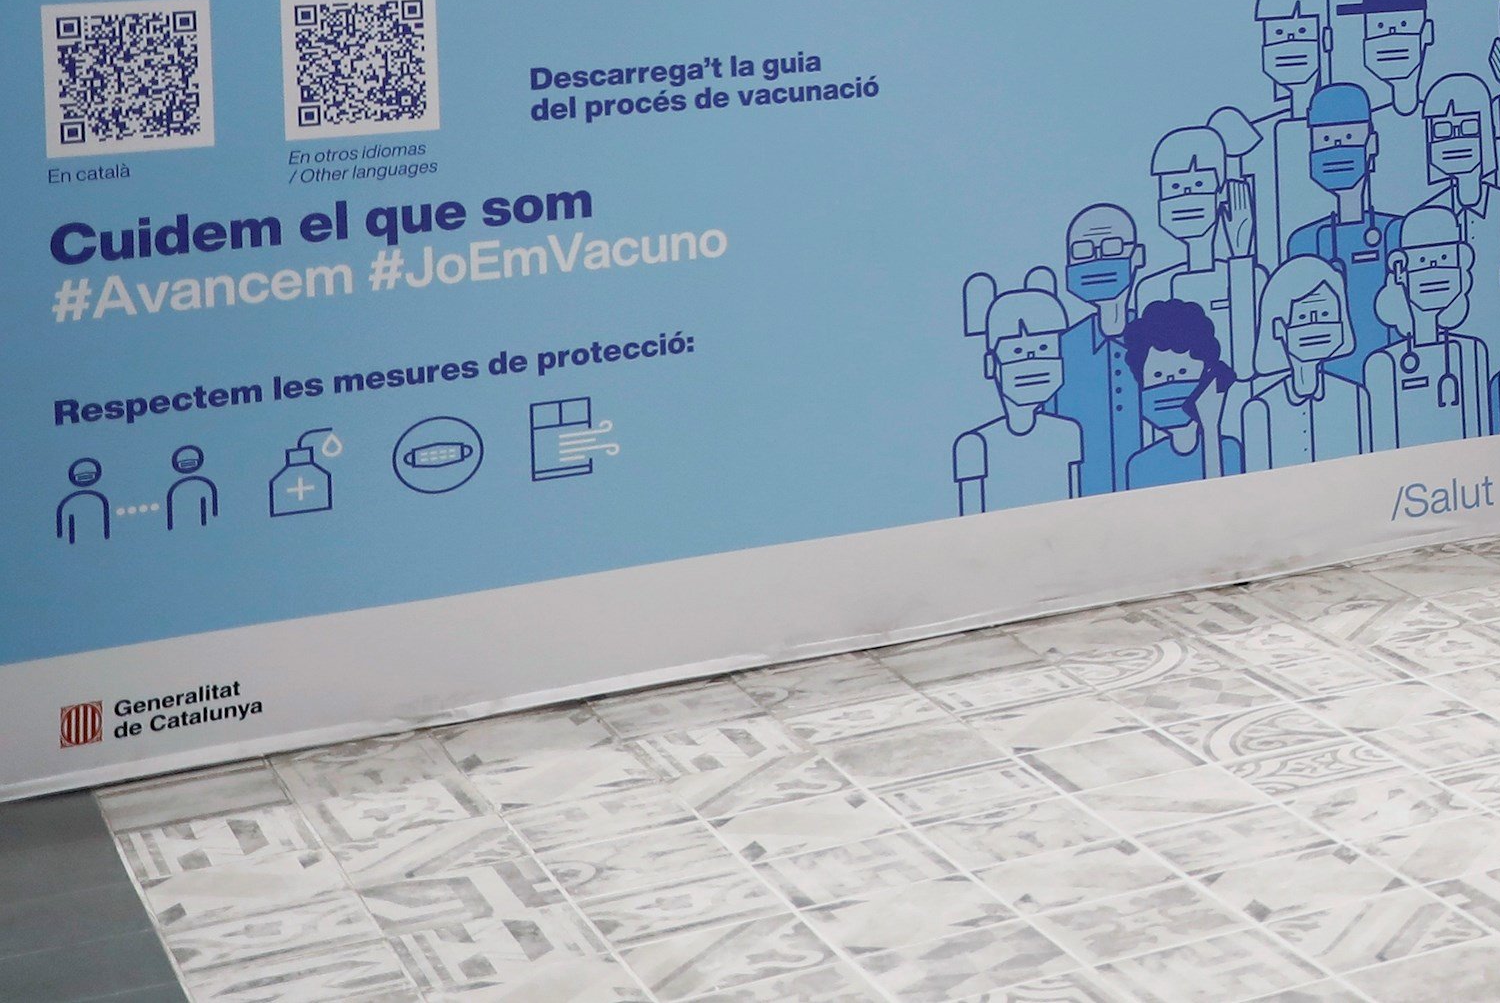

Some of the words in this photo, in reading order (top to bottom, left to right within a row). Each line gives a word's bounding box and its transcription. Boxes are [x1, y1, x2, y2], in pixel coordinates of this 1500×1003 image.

[729, 54, 755, 79] la
[761, 50, 822, 81] guia
[530, 96, 577, 122] del
[585, 89, 687, 123] procés
[694, 86, 730, 110] de
[738, 75, 880, 107] vacunació
[48, 169, 72, 184] En
[76, 163, 131, 183] català
[288, 149, 311, 165] En
[314, 148, 358, 164] otros
[362, 143, 427, 161] idiomas
[300, 165, 348, 183] Other
[352, 161, 439, 181] languages
[50, 213, 282, 266] Cuidem
[299, 200, 349, 243] el
[365, 201, 467, 246] que
[482, 189, 593, 228] som
[51, 263, 353, 323] #Avancem
[368, 227, 728, 292] #JoEmVacuno
[54, 383, 263, 426] Respectem
[273, 376, 324, 401] les
[333, 359, 480, 394] mesures
[488, 351, 528, 376] de
[537, 331, 695, 376] protecció:
[1391, 475, 1495, 521] /Salut
[114, 680, 241, 717] Generalitat
[113, 721, 143, 739] de
[149, 700, 263, 732] Catalunya
